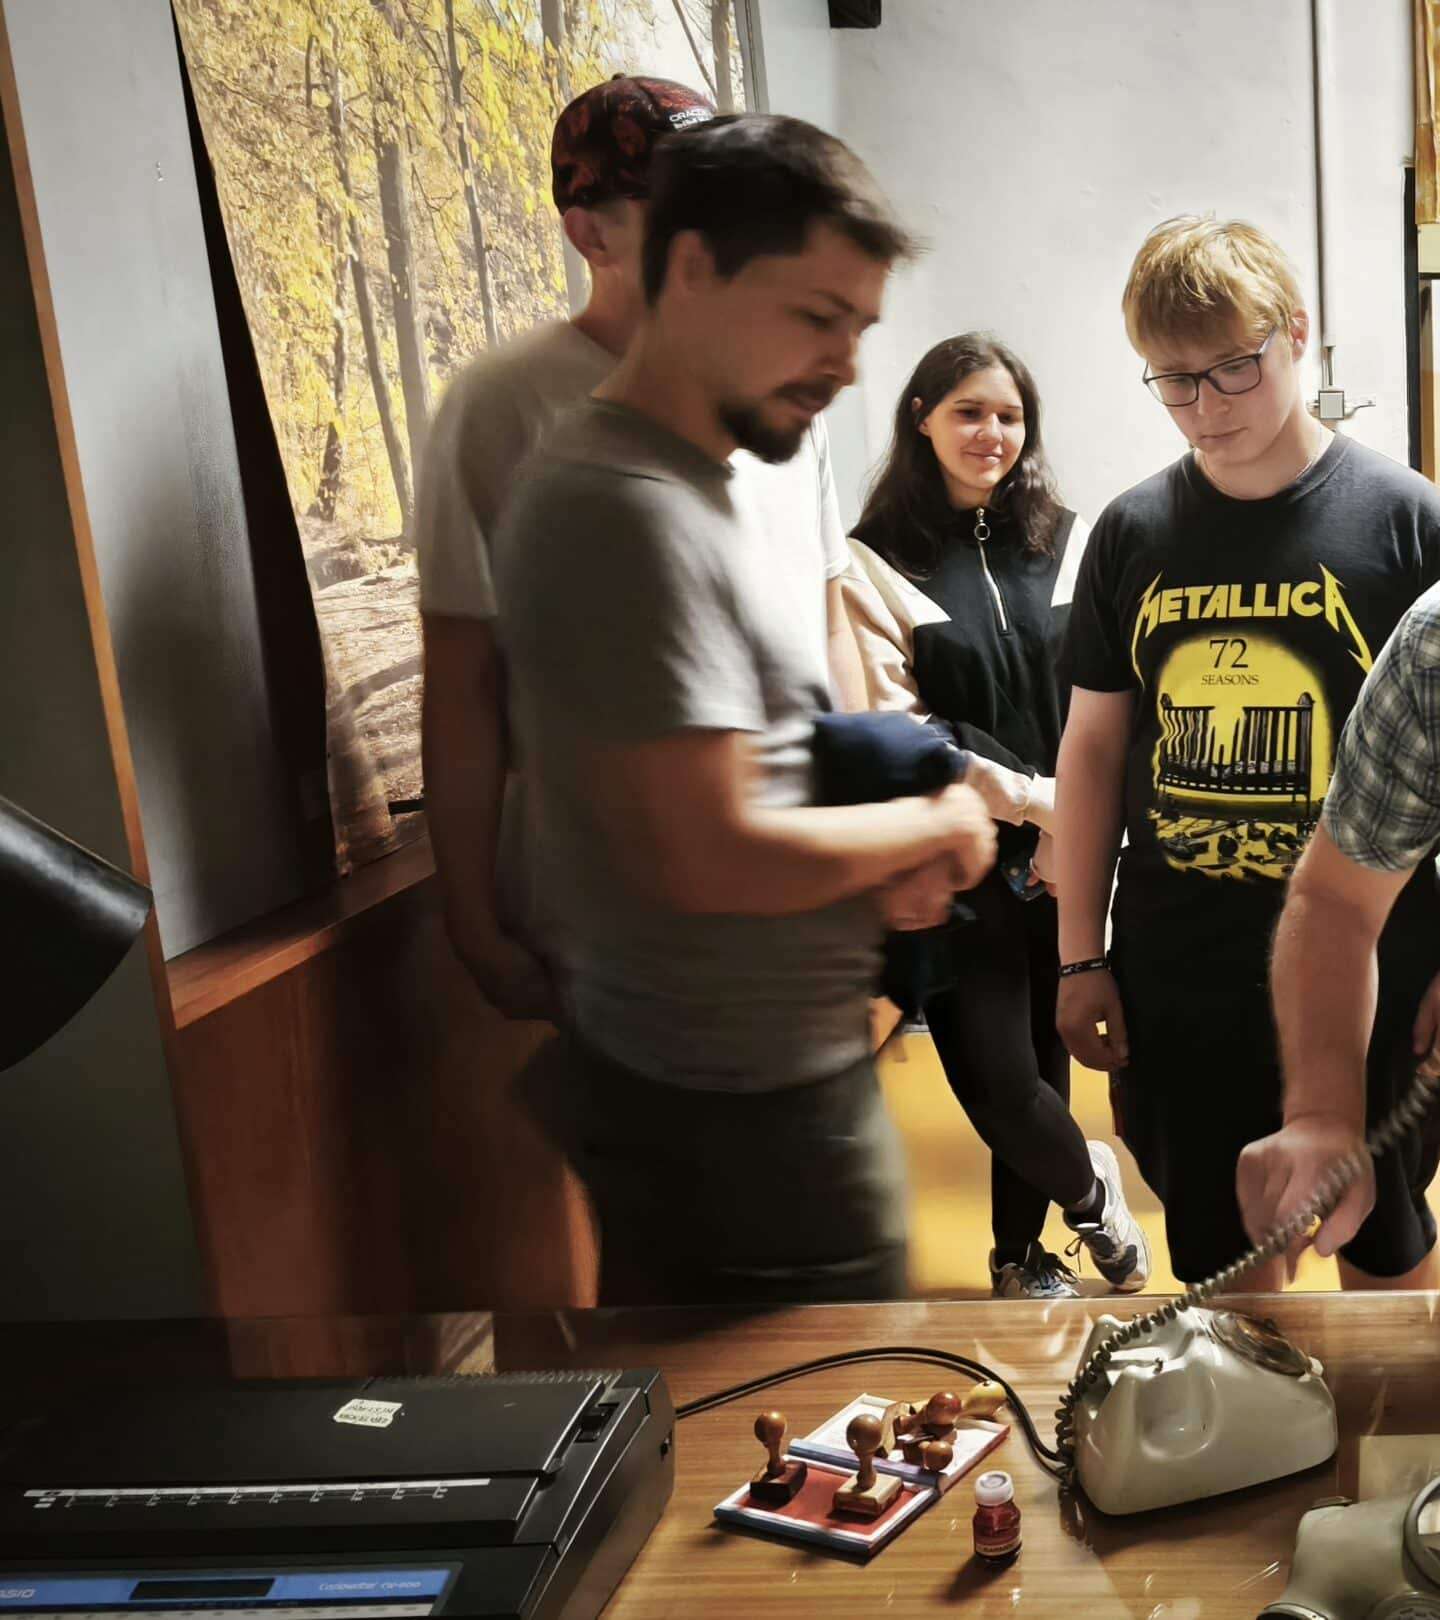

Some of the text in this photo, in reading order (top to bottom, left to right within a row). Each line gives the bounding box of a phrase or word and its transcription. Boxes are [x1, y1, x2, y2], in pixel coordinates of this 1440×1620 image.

[1131, 562, 1375, 688] METALLICA
[1209, 638, 1249, 668] 72
[1201, 674, 1259, 686] SEASONS
